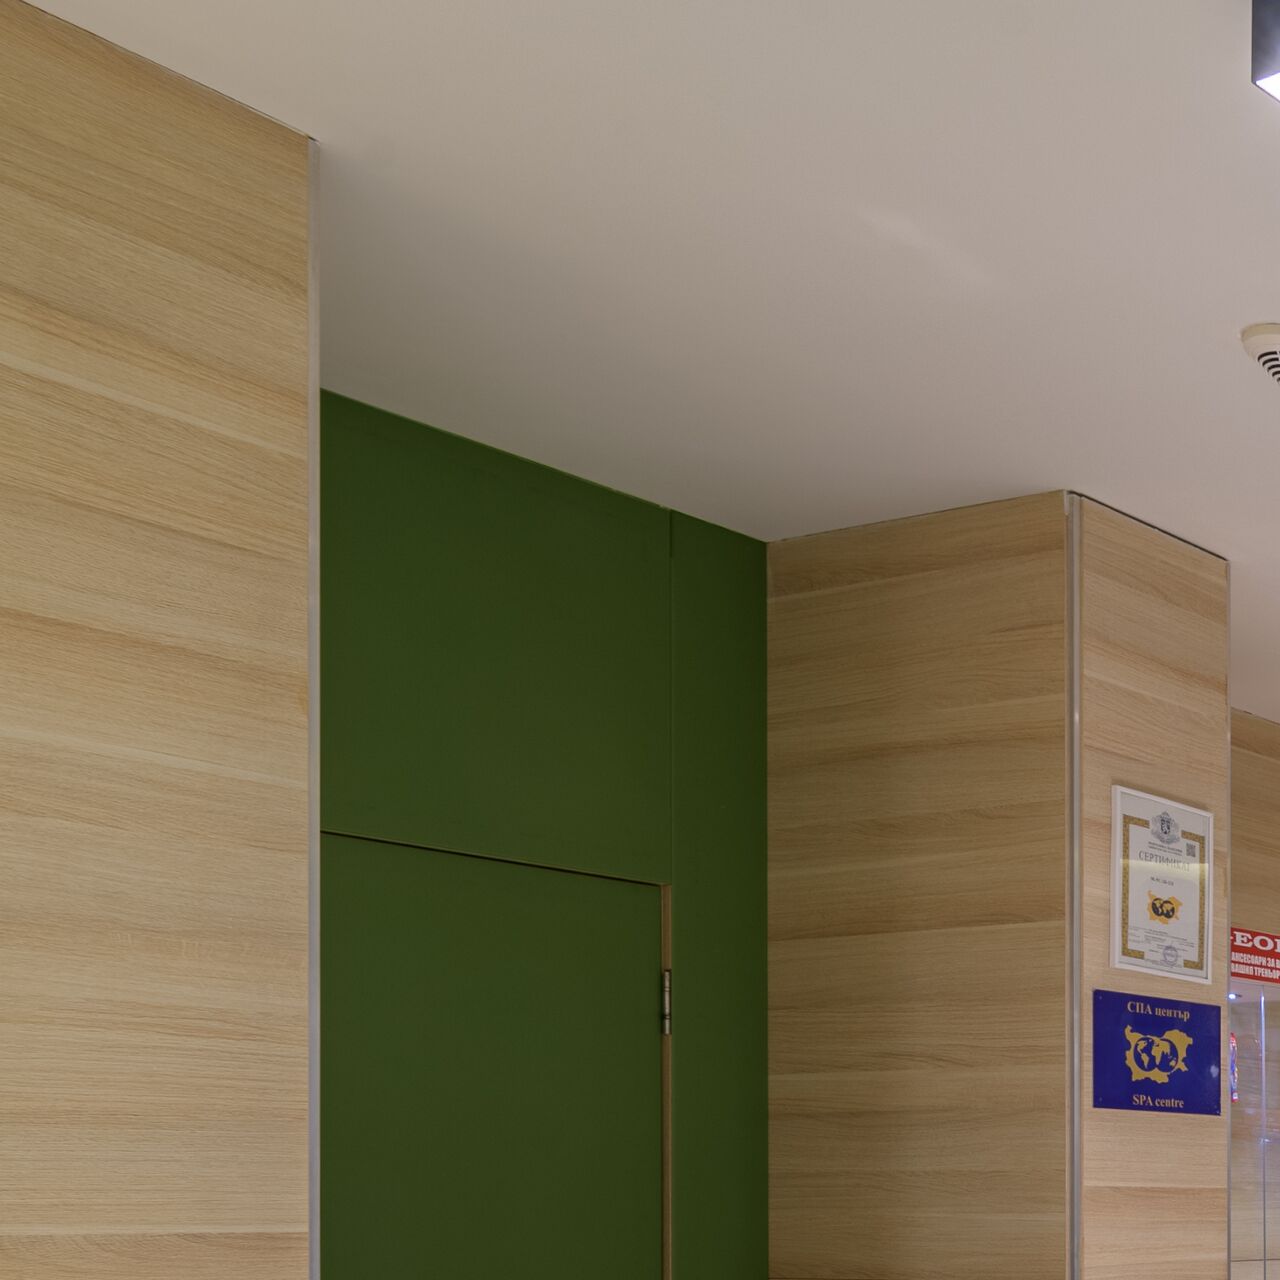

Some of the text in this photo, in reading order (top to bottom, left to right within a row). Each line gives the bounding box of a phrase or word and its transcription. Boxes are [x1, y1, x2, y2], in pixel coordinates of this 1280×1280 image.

[1127, 1001, 1190, 1022] СПА център
[1132, 1094, 1185, 1109] SPA centre
